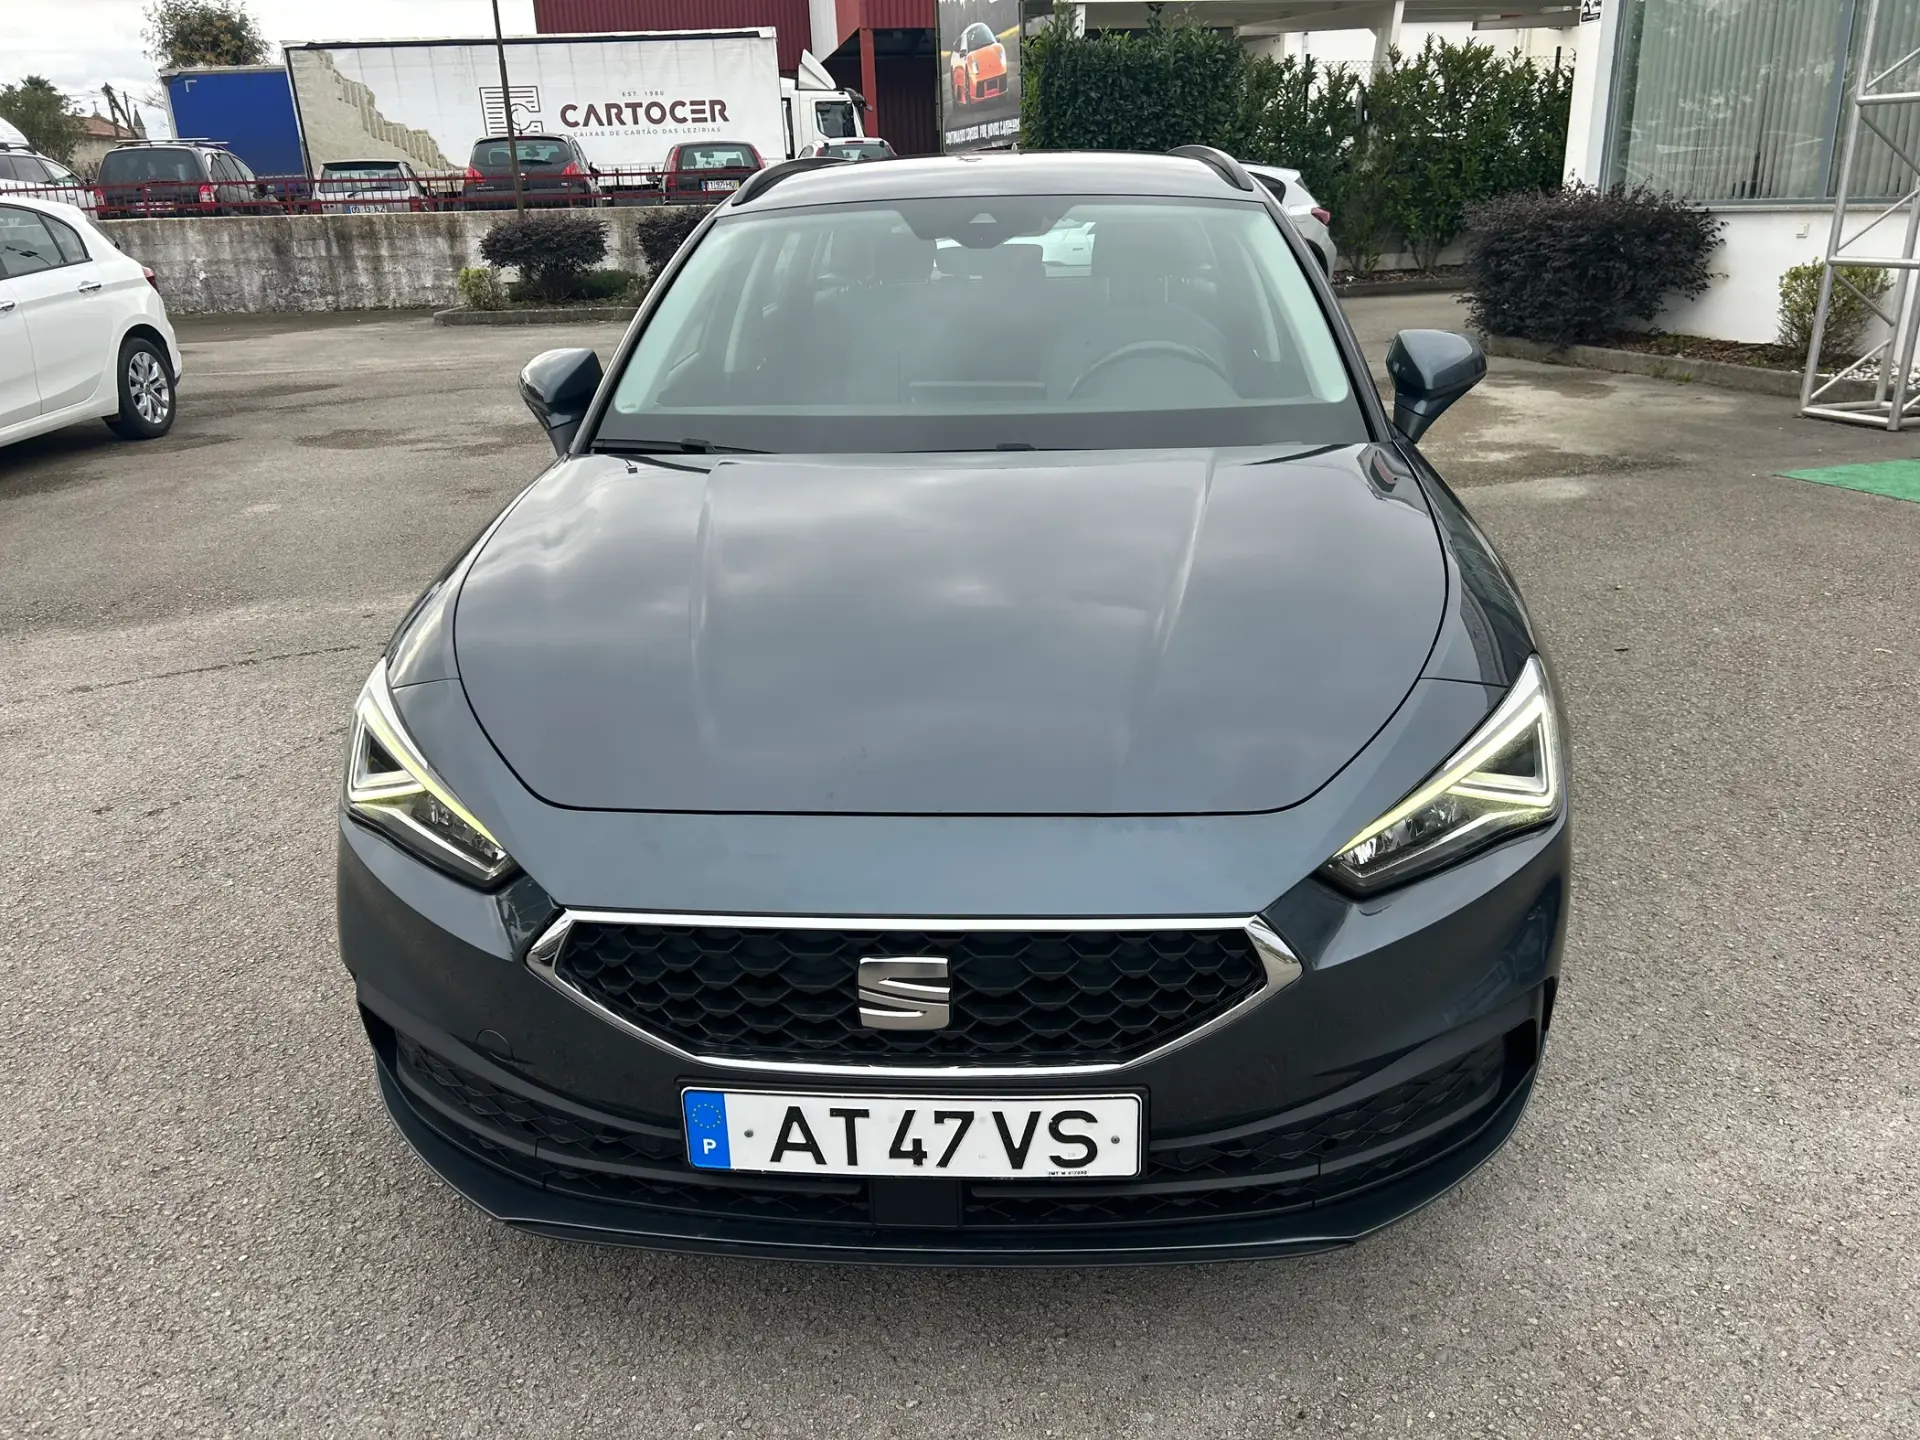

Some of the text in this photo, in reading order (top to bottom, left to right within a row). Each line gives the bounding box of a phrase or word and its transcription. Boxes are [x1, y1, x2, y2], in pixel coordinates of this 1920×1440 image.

[560, 99, 730, 128] CARTOCER
[573, 130, 605, 138] CAIXAS
[624, 127, 658, 136] CARTÃO
[662, 127, 679, 135] DAS
[682, 126, 721, 134] LEZÍRIAS
[702, 1138, 717, 1155] P
[770, 1105, 1098, 1170] AT 47 VS
